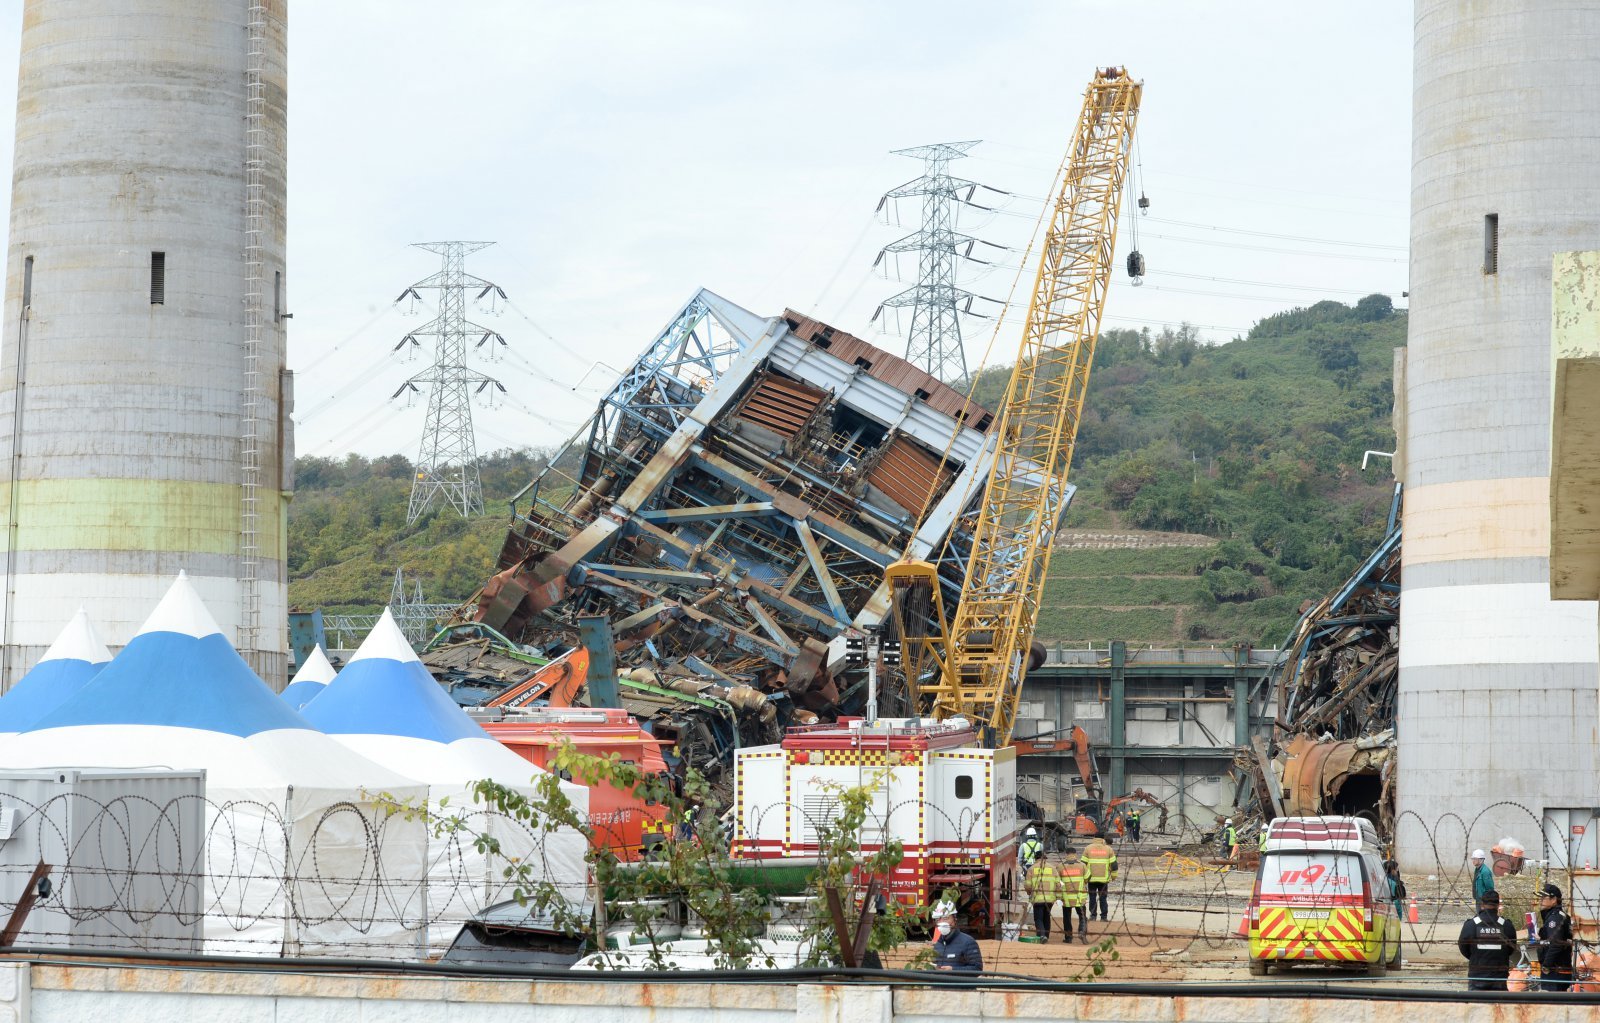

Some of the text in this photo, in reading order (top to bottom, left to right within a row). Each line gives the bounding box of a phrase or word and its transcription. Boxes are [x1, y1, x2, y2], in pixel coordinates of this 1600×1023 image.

[508, 685, 541, 707] DEVELON
[1277, 864, 1348, 886] 119 구급대
